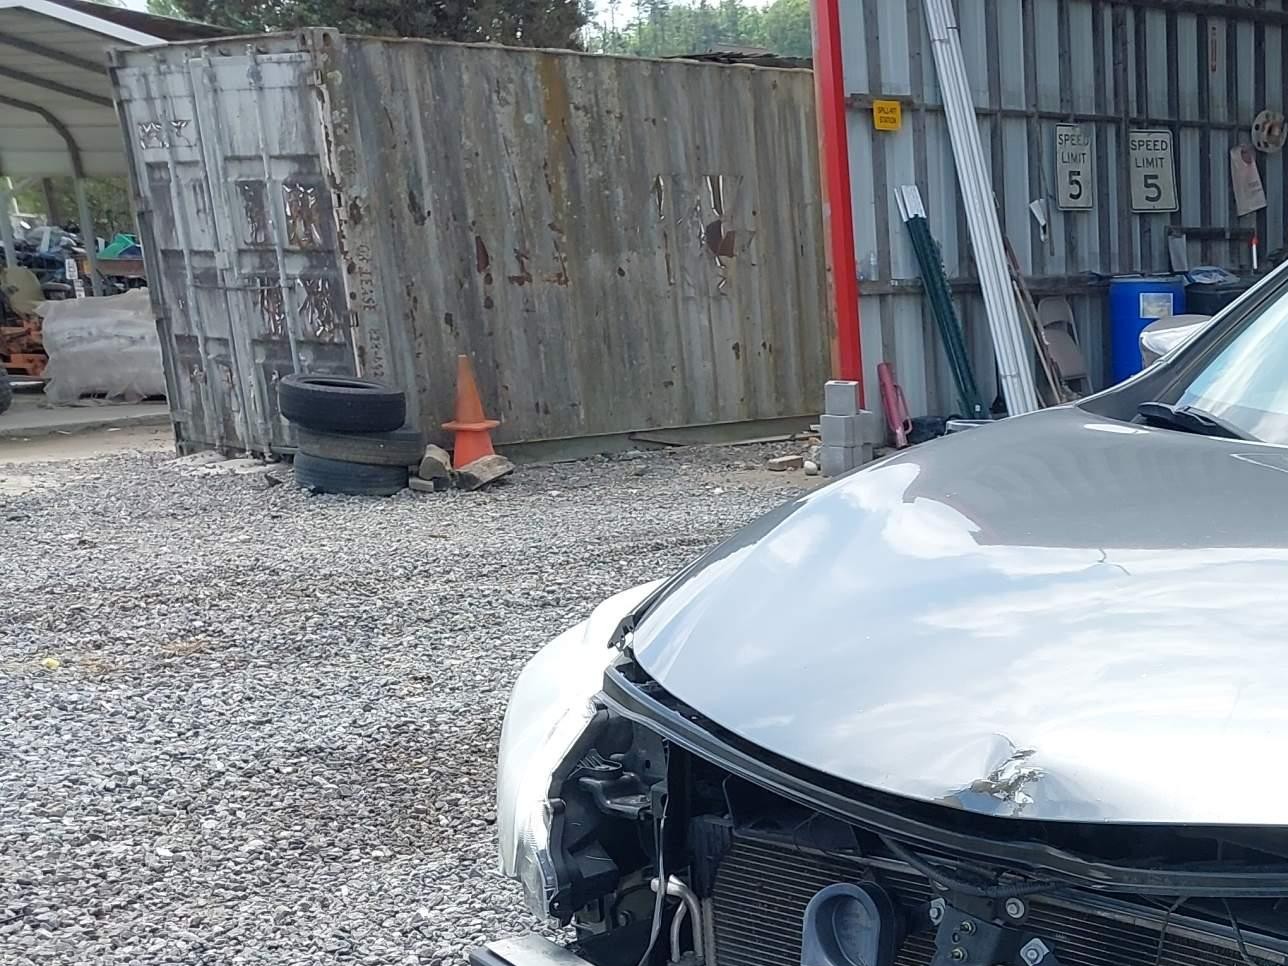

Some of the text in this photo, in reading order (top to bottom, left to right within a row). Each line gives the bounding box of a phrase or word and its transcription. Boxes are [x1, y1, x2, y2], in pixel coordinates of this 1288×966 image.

[1058, 134, 1089, 146] SPEED
[1130, 139, 1169, 151] SPEED
[1061, 152, 1087, 164] LIMIT
[1134, 157, 1165, 169] LIMIT
[1068, 170, 1082, 200] 5
[1143, 174, 1162, 203] 5
